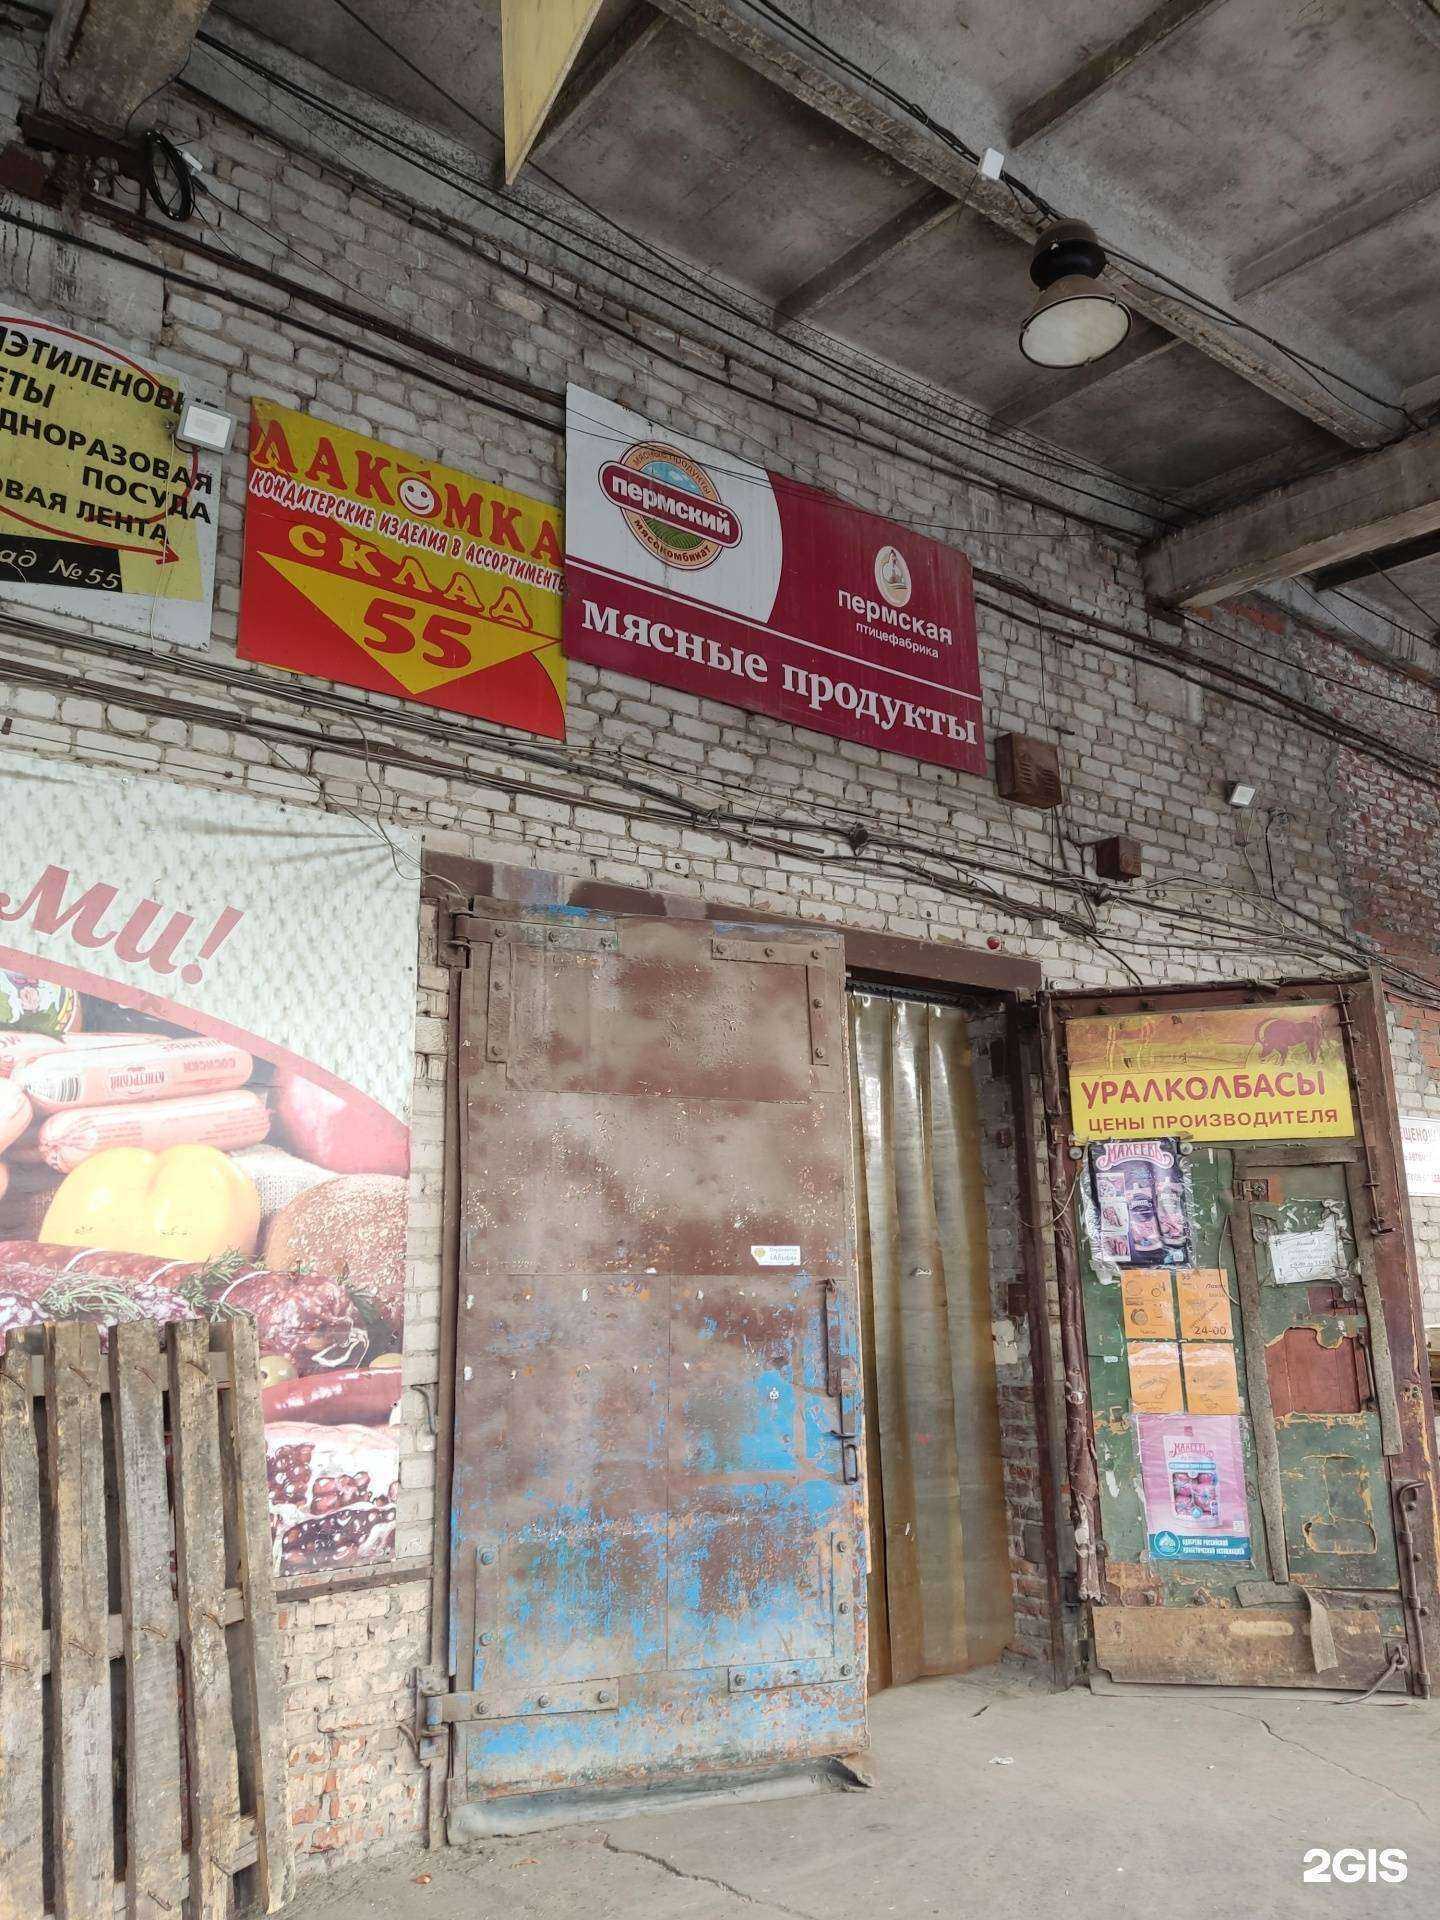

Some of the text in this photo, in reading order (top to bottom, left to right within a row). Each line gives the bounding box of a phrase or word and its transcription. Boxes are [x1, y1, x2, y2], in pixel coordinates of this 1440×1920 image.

[0, 325, 217, 414] ЭТИЛЕНОВ
[76, 500, 170, 545] ЛЕНТА
[82, 466, 211, 524] ПОСУДА
[250, 469, 376, 530] КОНДИТЕРСКИЕ
[378, 511, 448, 556] ИЗДЕЛИЯ
[450, 536, 462, 558] В
[289, 524, 533, 630] СКЛАД
[363, 597, 471, 669] 55
[856, 622, 939, 659] птицефабрика
[1081, 1070, 1326, 1110] УРАЛКОЛБАСЫ
[1089, 1109, 1338, 1133] ЦЕНЫ ПРОИЗВОДИТЕЛЯ
